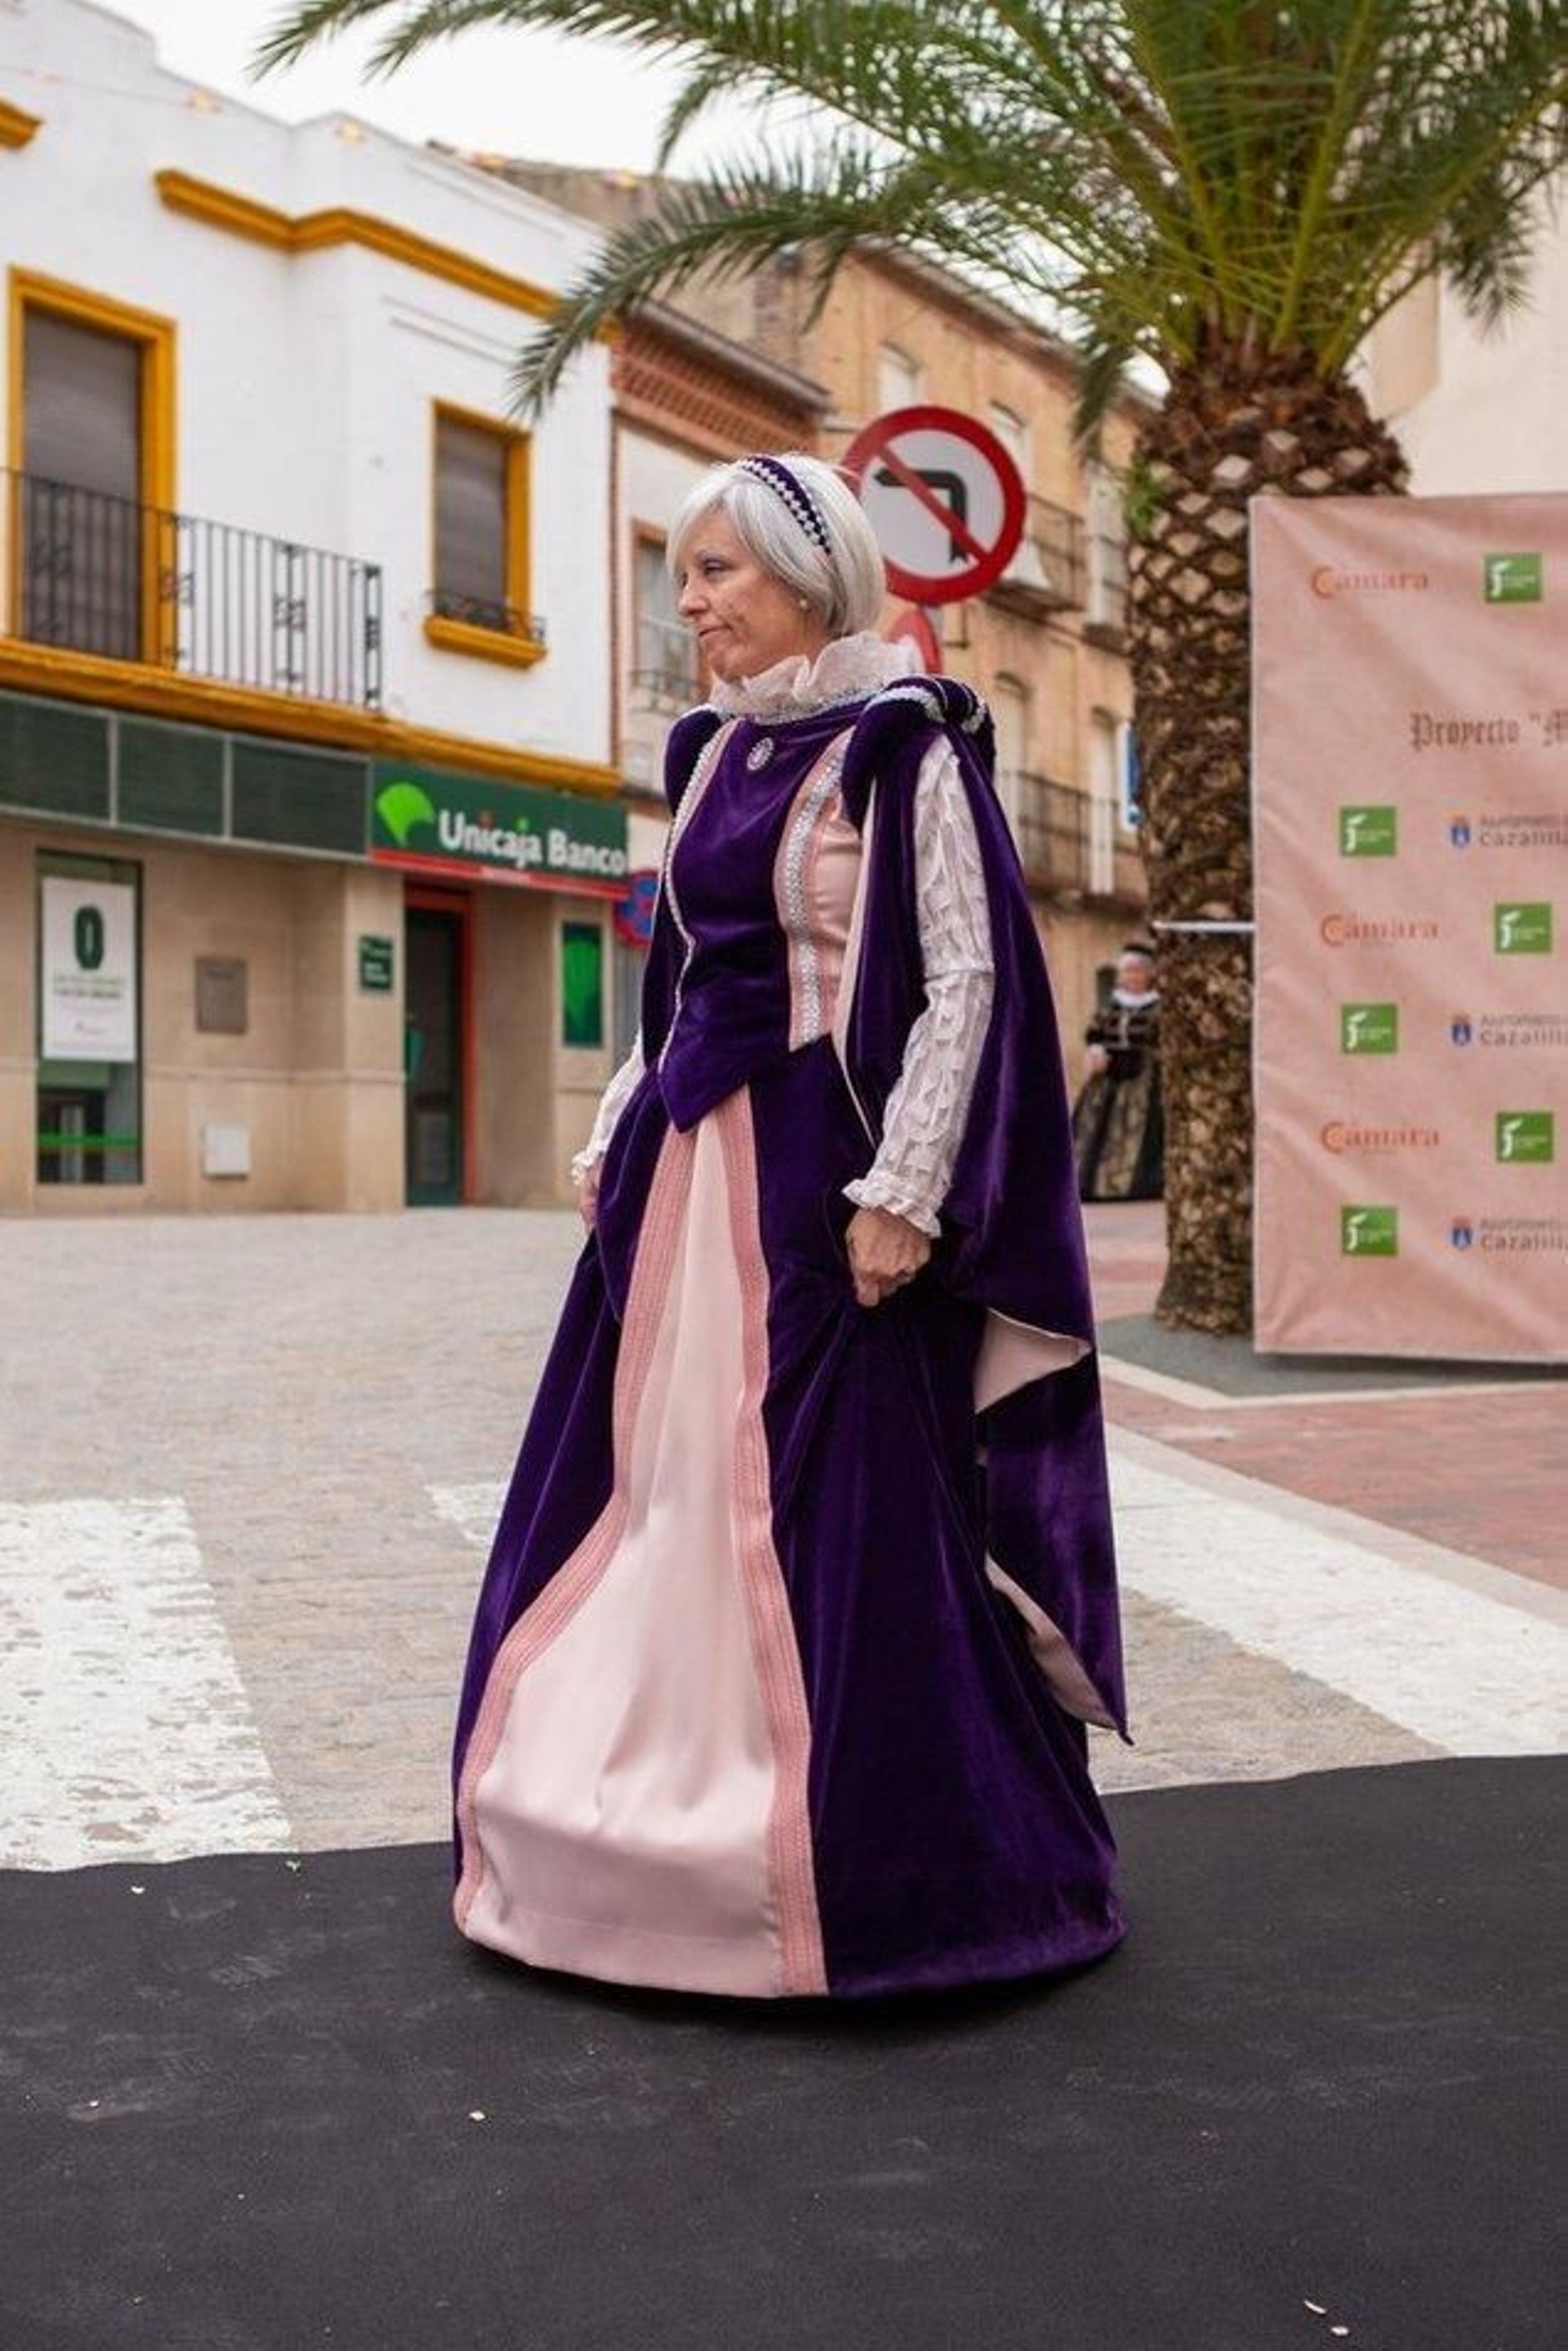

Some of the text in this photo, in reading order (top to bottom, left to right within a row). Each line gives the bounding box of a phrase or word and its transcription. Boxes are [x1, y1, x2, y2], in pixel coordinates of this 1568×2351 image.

[1410, 711, 1520, 752] Proyecto
[438, 809, 625, 875] Unicaja Banco
